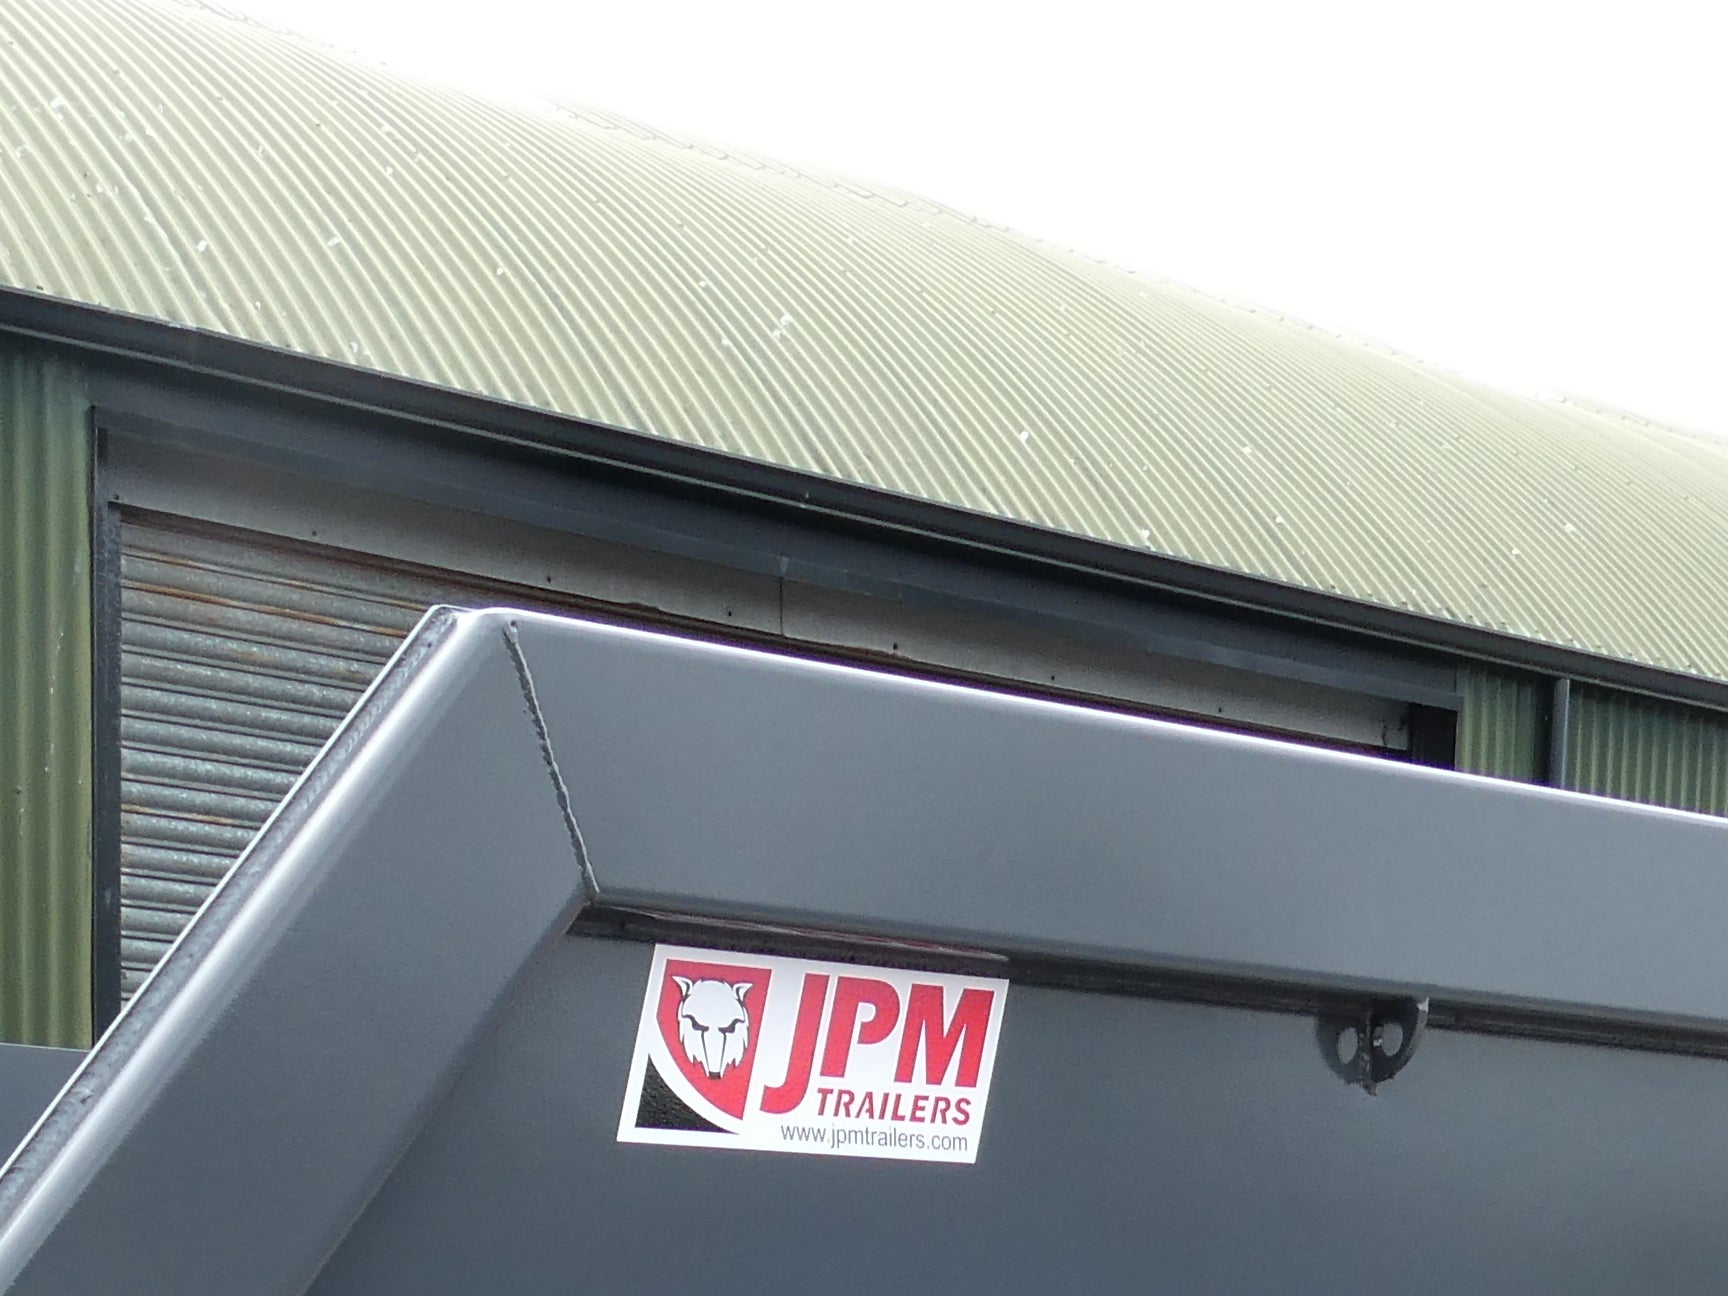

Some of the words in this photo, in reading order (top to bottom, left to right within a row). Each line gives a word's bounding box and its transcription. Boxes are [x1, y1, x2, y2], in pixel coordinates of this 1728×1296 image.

[760, 972, 994, 1114] JPM
[816, 1087, 971, 1126] TRAILERS
[781, 1123, 969, 1151] www.jpmtrailers.com
